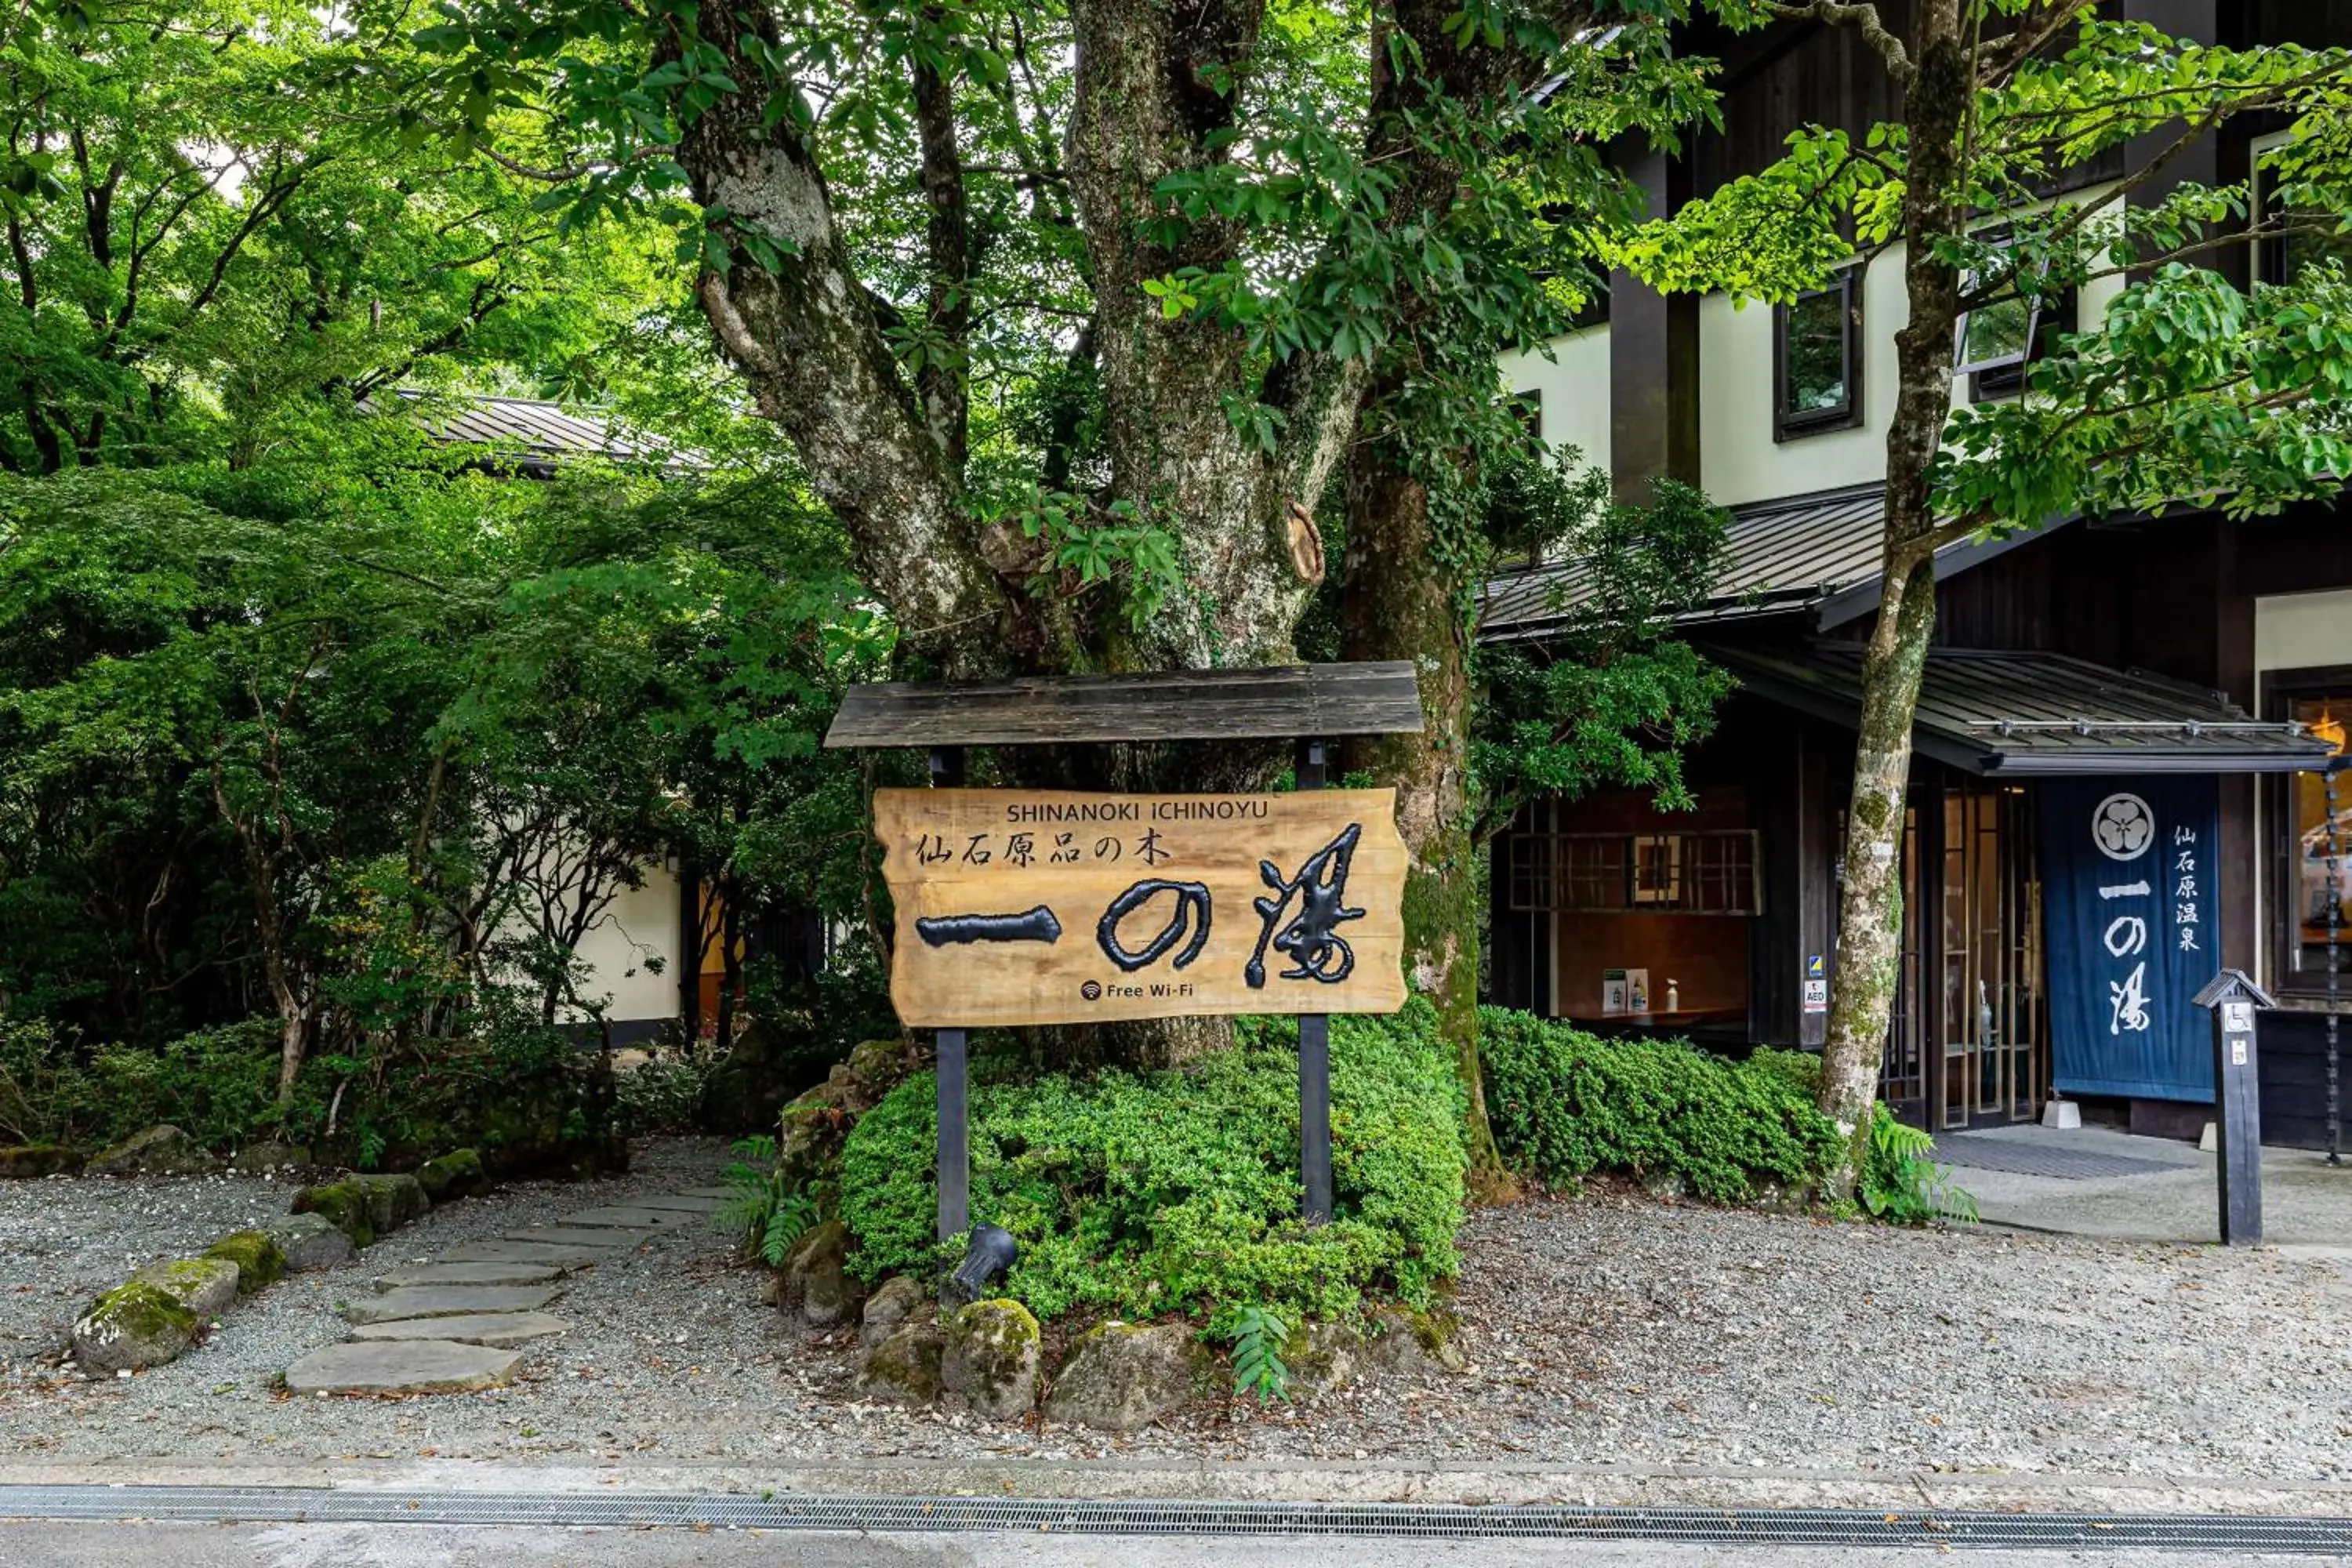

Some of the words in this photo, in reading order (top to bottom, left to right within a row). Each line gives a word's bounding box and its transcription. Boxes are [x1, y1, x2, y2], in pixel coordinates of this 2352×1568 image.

[1007, 803, 1139, 822] SHINANOKI
[915, 827, 1171, 868] 仙石原品の木
[2174, 825, 2199, 951] 仙石原温泉
[1107, 984, 1144, 997] Free
[1149, 983, 1193, 997] Wi-Fi
[1806, 992, 1824, 1001] AED
